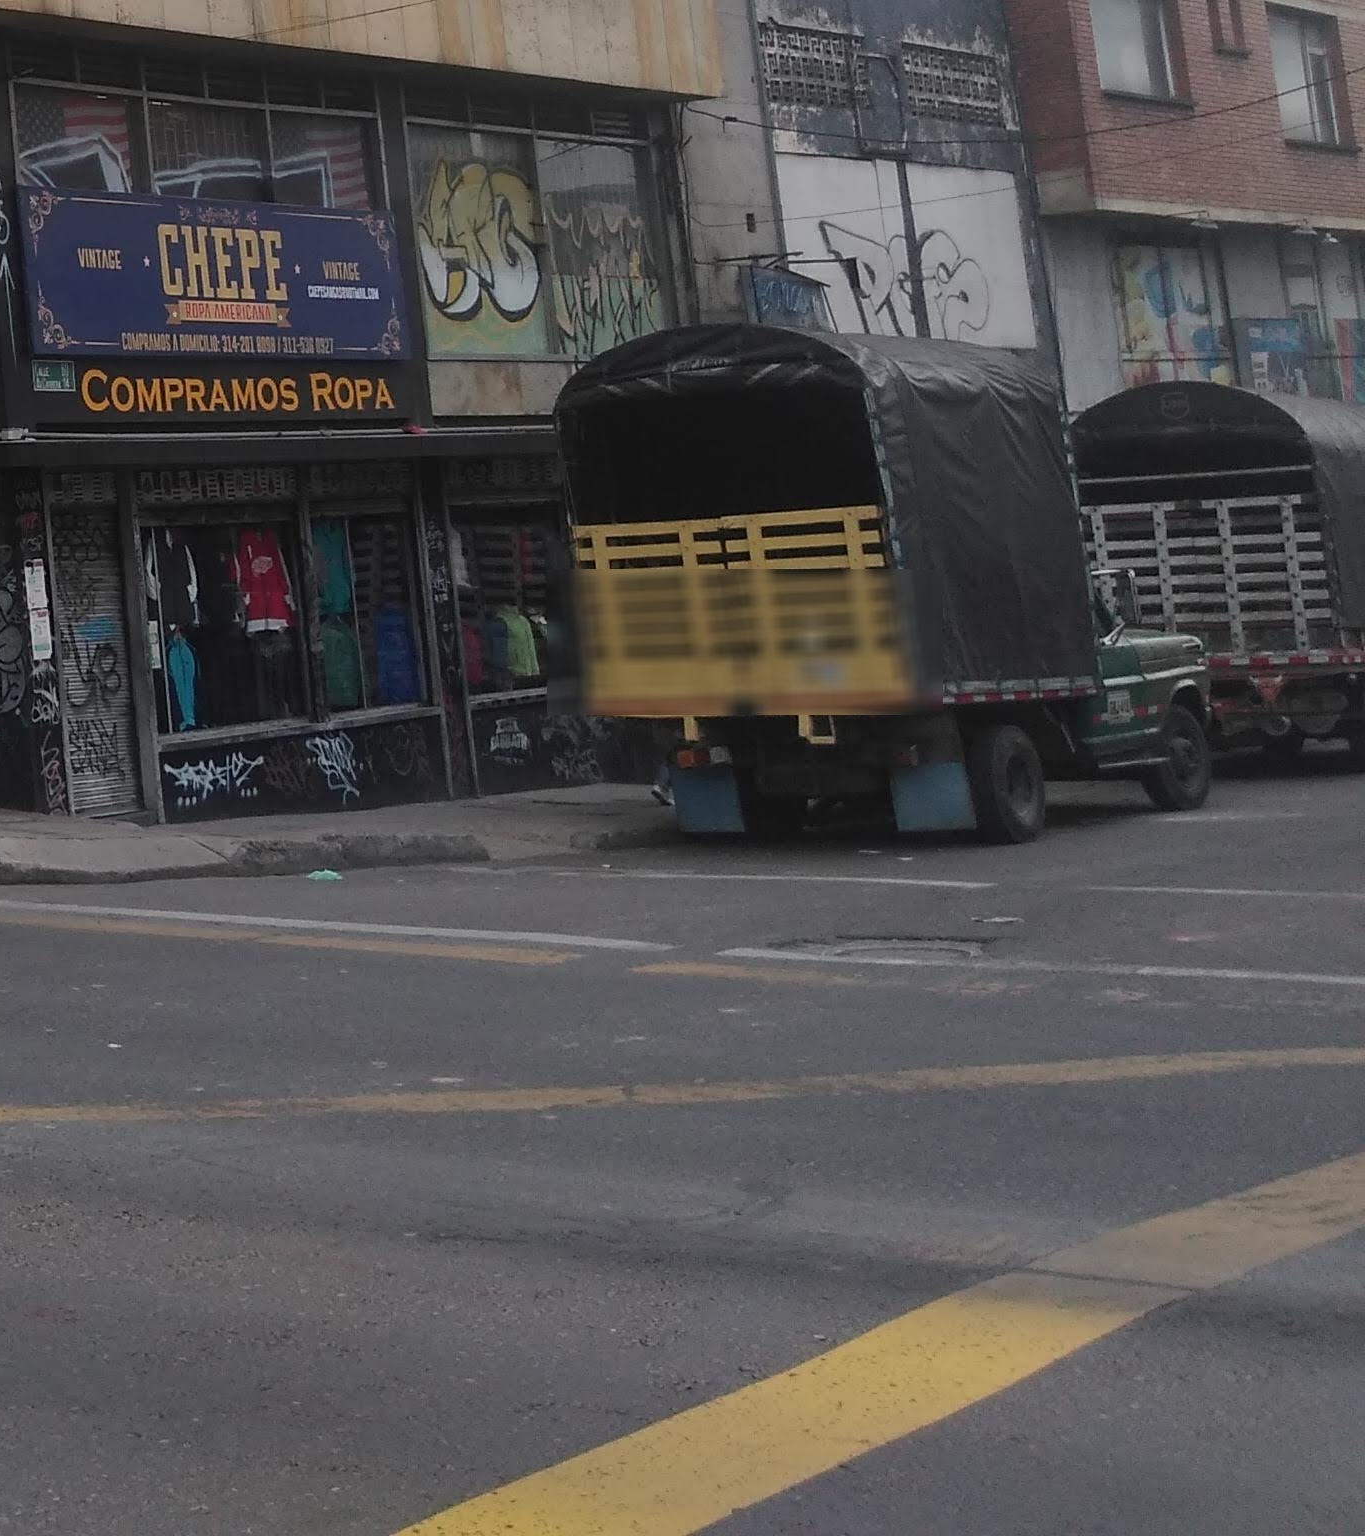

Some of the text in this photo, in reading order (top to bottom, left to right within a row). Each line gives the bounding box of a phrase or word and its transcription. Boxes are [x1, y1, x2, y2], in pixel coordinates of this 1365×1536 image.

[77, 248, 122, 270] VINTAGE
[157, 223, 288, 302] CHEPE
[322, 260, 360, 281] VINTAGE
[185, 301, 275, 322] ROPA AMERICANA
[121, 332, 171, 351] COMPRAMOS
[172, 333, 179, 351] A
[180, 334, 221, 352] DOMICILIO:
